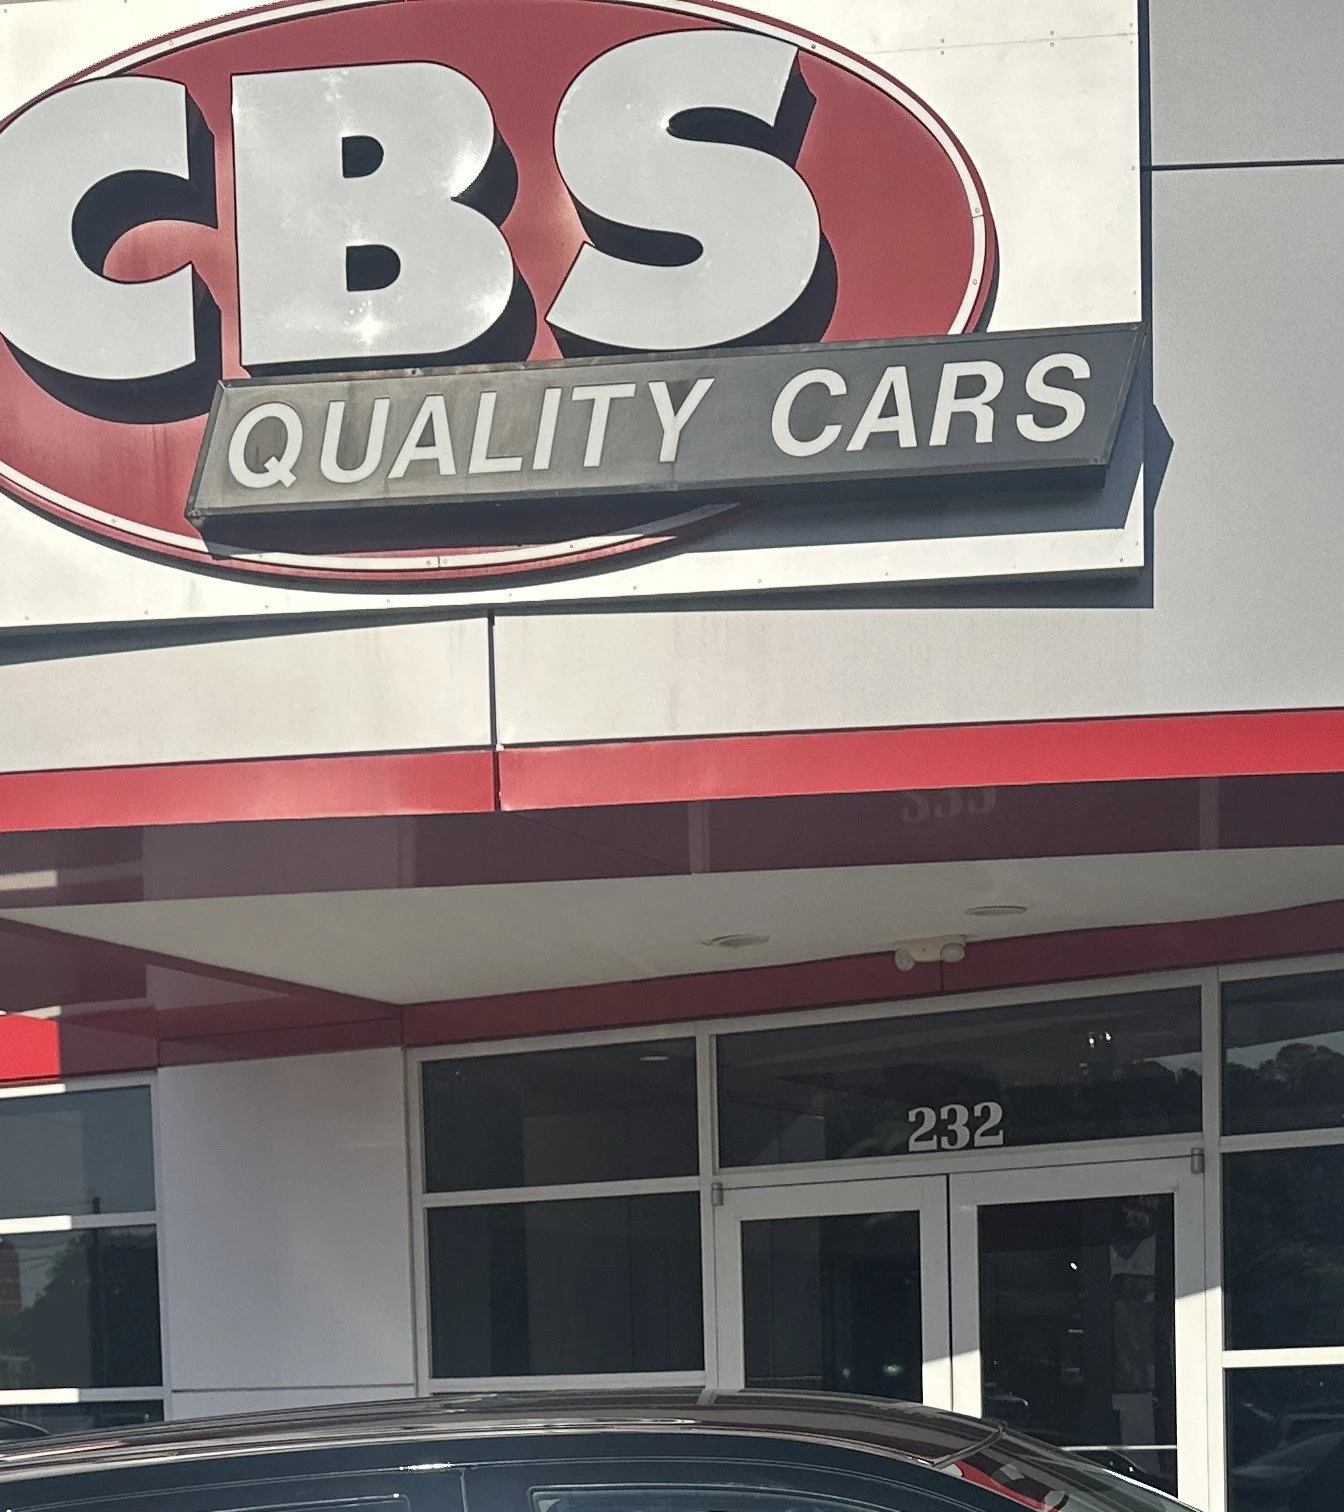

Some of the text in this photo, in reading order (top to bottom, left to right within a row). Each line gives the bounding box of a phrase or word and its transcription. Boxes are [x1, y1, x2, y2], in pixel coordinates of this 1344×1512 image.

[226, 351, 1091, 489] QUALITY CARS
[908, 1101, 1004, 1152] 232
